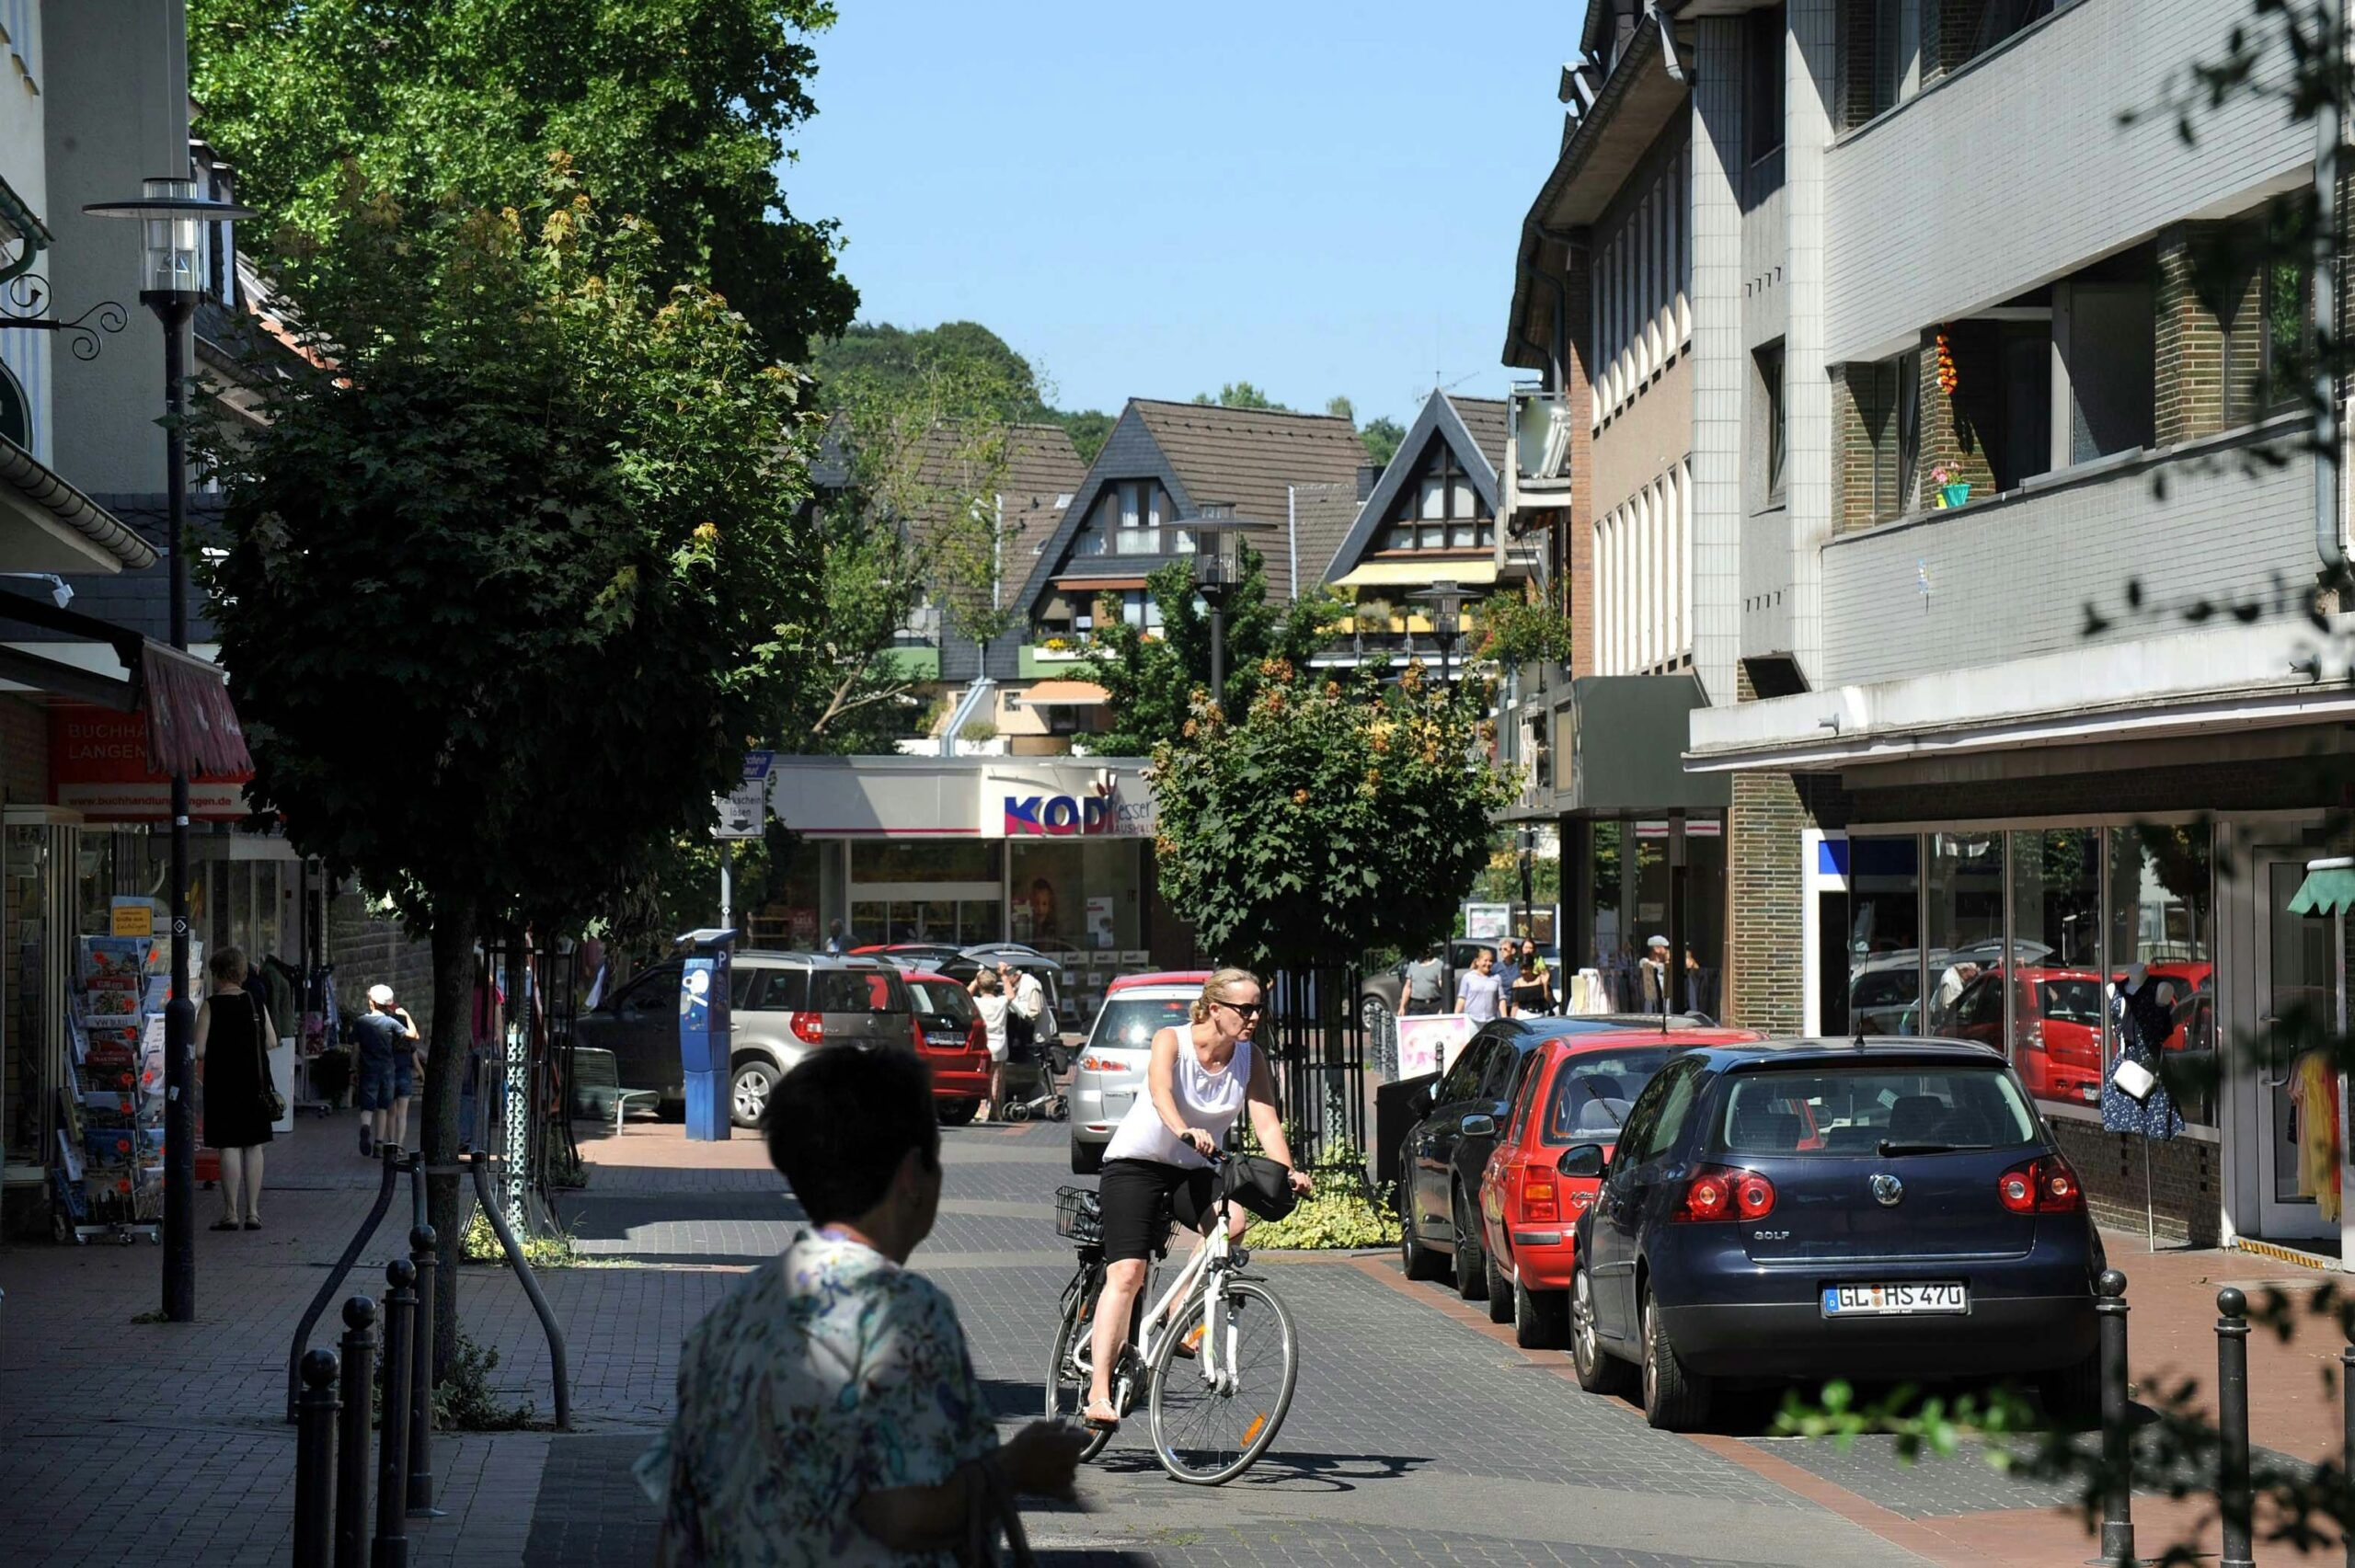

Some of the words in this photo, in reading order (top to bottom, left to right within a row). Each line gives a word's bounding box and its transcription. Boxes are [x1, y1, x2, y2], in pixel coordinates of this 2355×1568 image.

[729, 807, 752, 817] lösen
[1116, 801, 1152, 820] esser
[718, 950, 727, 967] P
[1753, 1230, 1790, 1241] GOLF
[1840, 1286, 1868, 1308] GL
[1885, 1285, 1914, 1306] HS
[1920, 1283, 1961, 1306] 470
